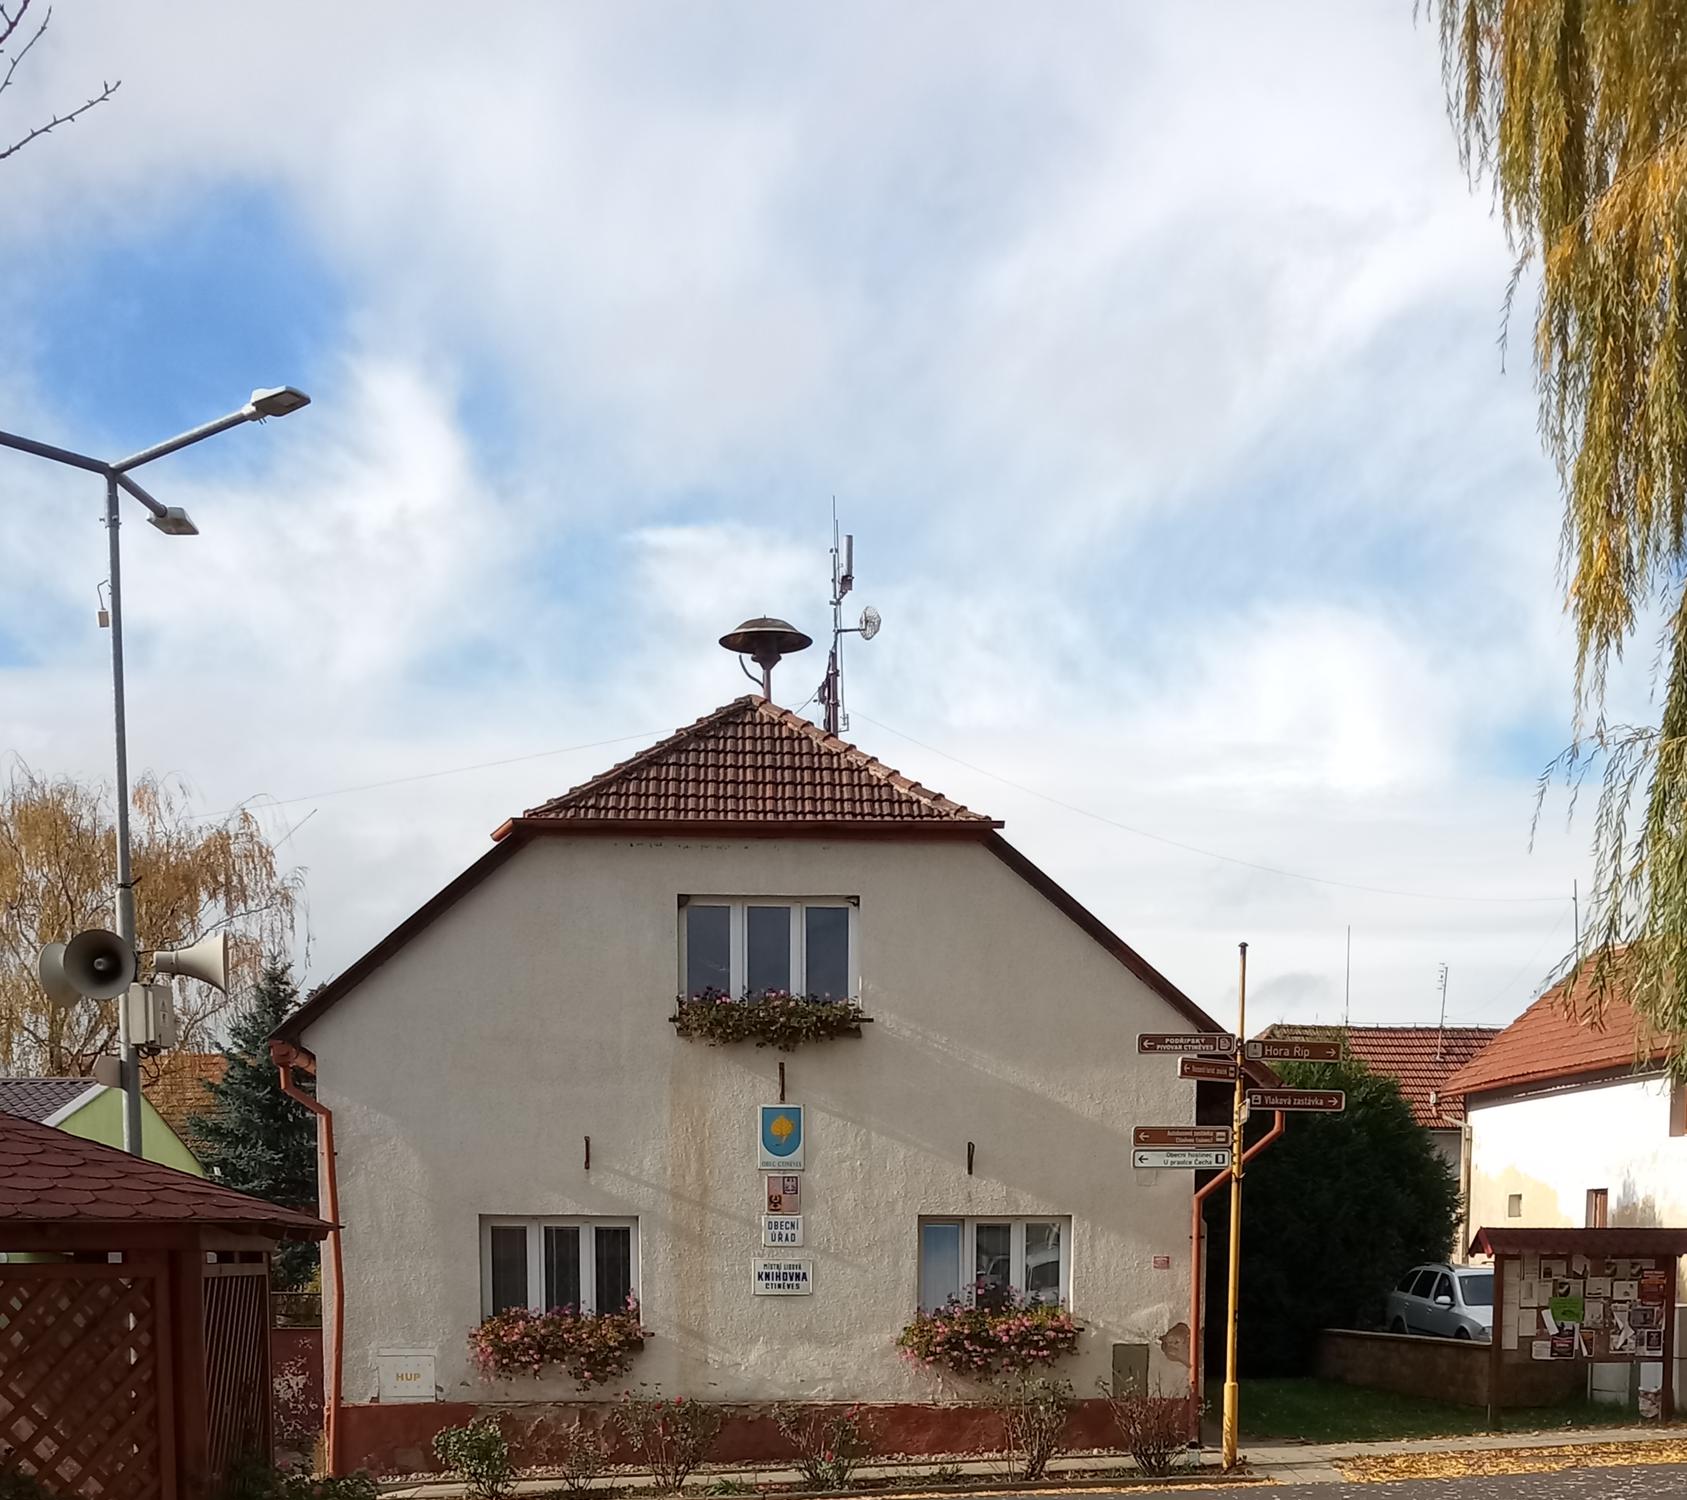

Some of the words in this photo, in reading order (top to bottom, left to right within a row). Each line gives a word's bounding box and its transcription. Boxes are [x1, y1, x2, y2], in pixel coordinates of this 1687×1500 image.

[1264, 1045, 1290, 1057] Hora
[1293, 1045, 1310, 1059] Říp
[1264, 1095, 1292, 1105] Vlaková
[1293, 1096, 1324, 1106] zastávka
[767, 1219, 799, 1230] OBECNÍ
[771, 1230, 796, 1242] ÚŘAD
[757, 1271, 808, 1282] KNIHOVNA
[765, 1282, 801, 1290] CTINĚVES
[396, 1373, 421, 1382] HUP
